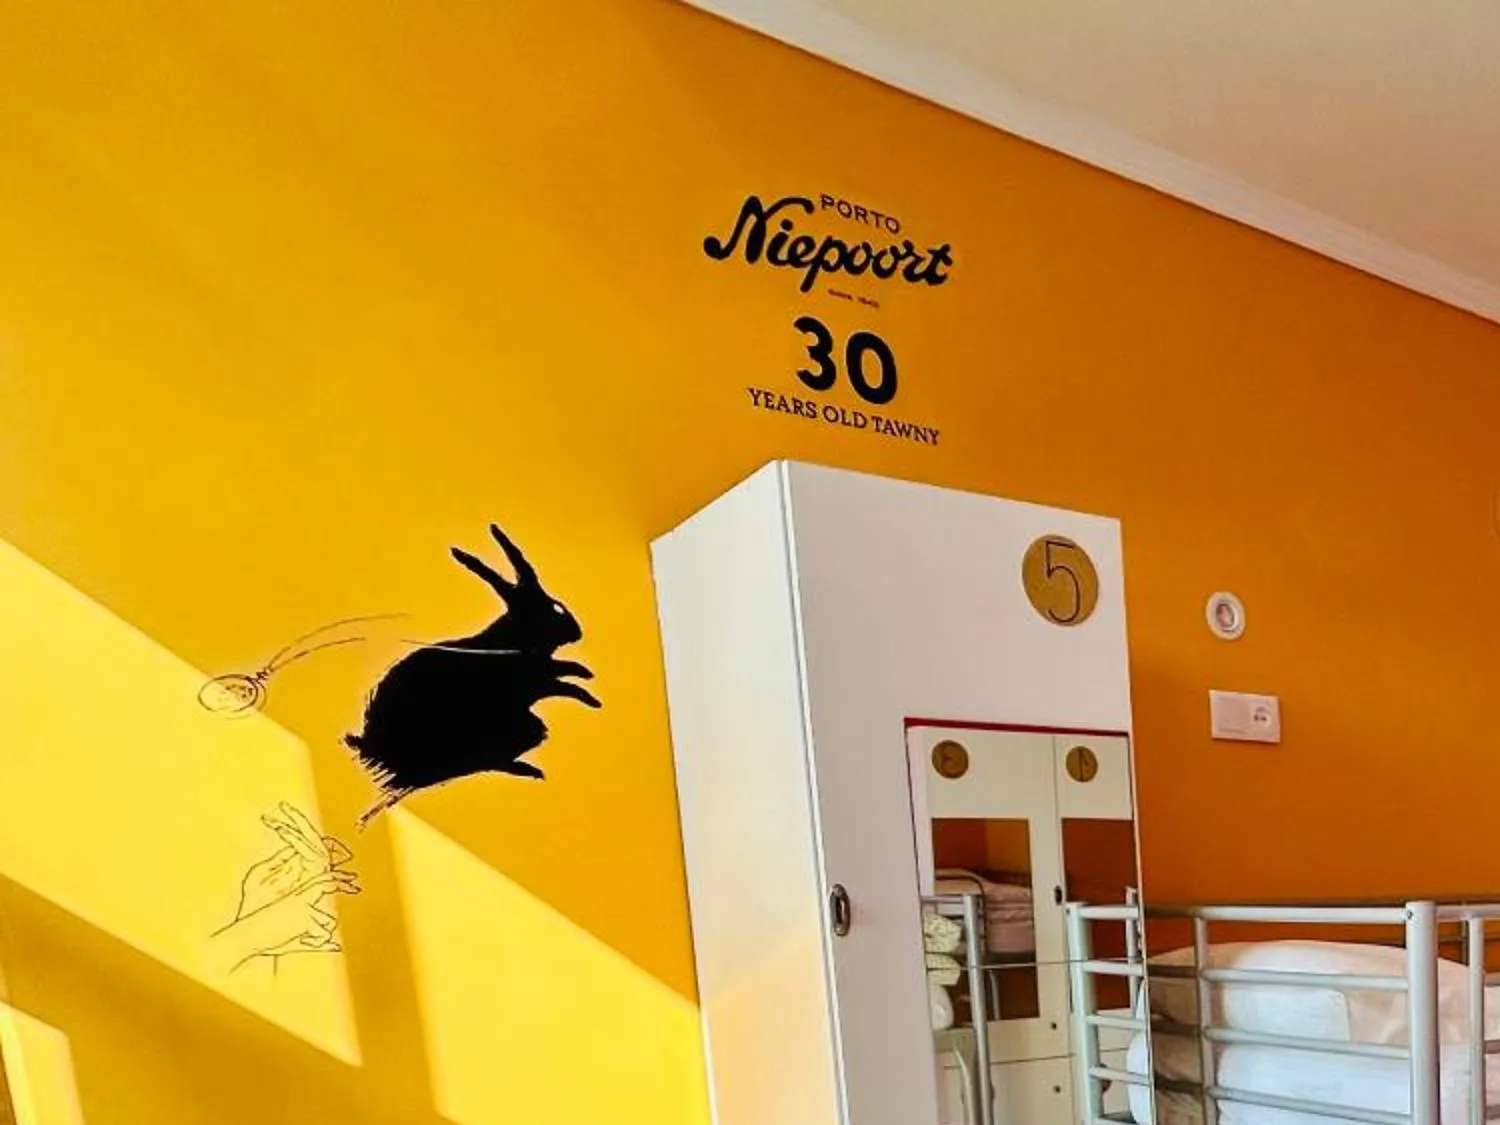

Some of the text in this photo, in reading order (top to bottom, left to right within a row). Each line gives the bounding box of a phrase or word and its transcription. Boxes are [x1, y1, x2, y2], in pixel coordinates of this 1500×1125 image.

[703, 195, 953, 293] Niepoort
[820, 193, 902, 235] PORTO
[793, 316, 898, 405] 30
[747, 387, 940, 446] YEARS OLD TAWNY
[1045, 540, 1081, 623] 5
